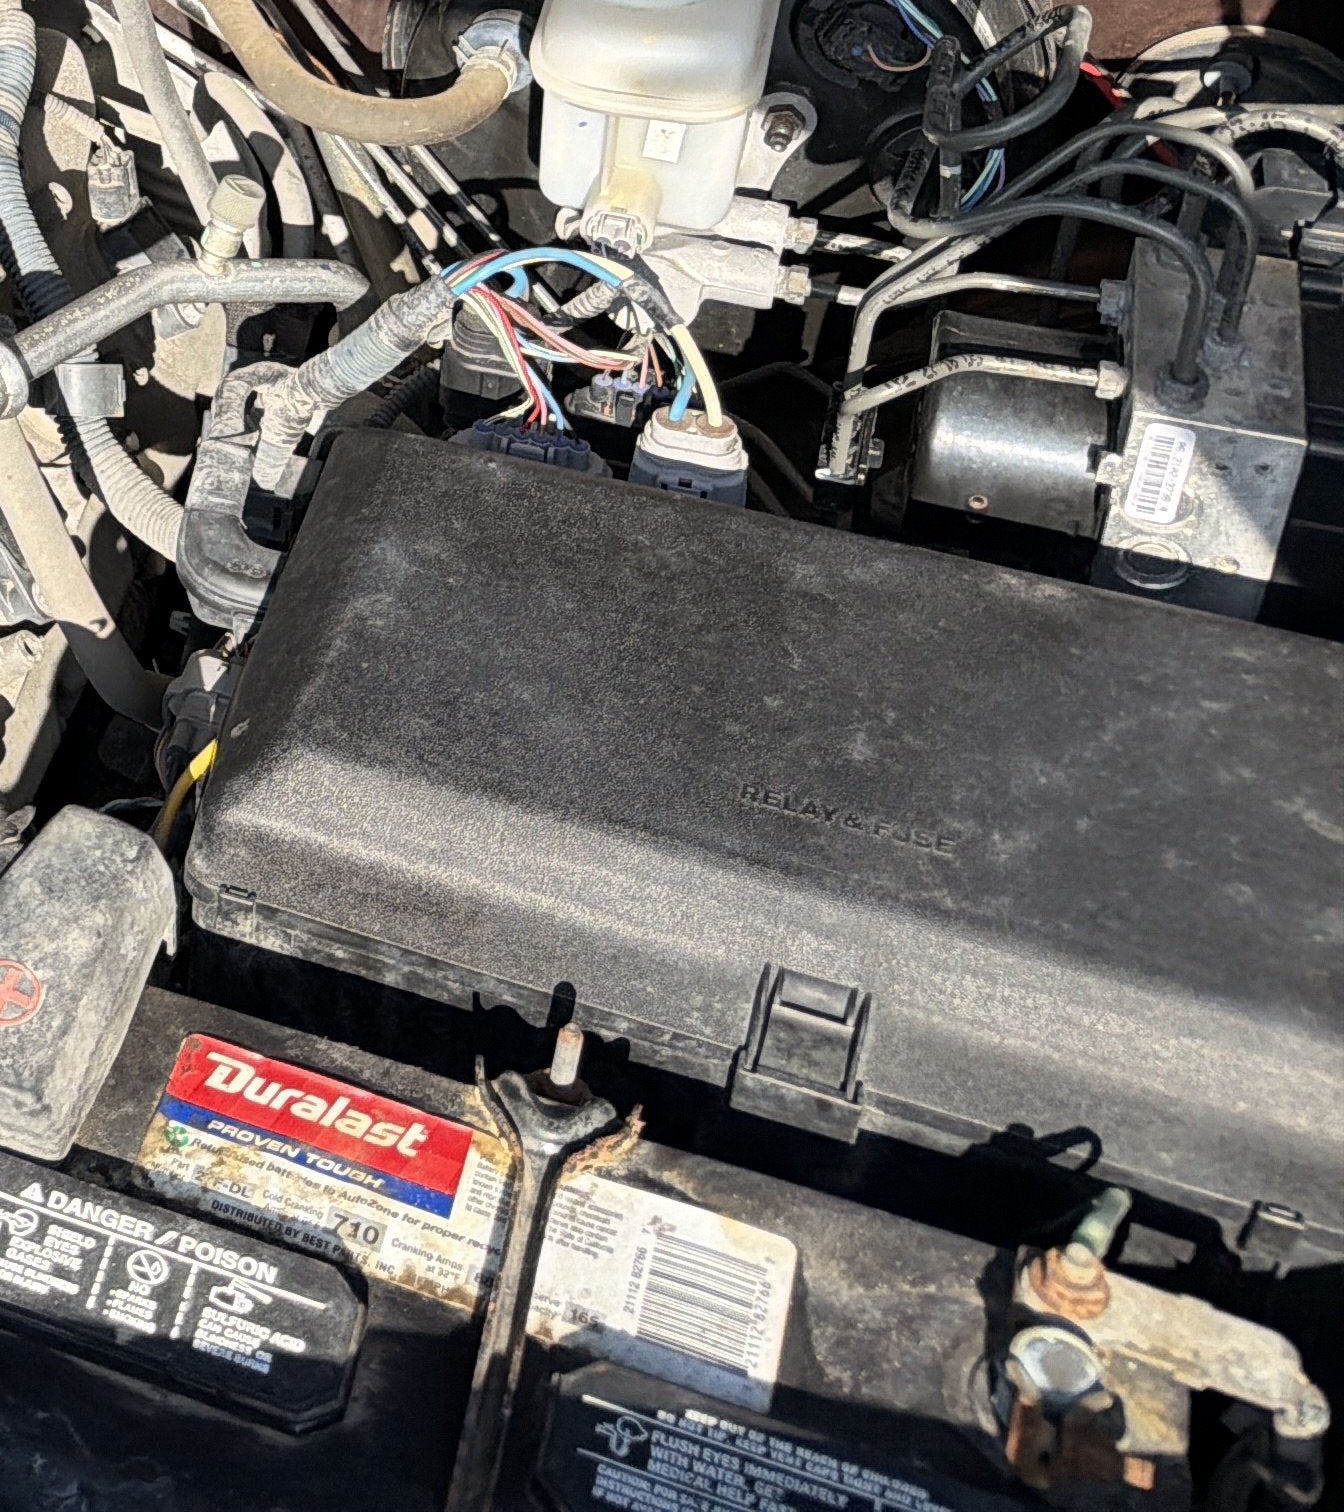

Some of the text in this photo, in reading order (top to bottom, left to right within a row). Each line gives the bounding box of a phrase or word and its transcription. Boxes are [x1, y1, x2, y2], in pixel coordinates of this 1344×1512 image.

[739, 782, 840, 826] RELAY
[873, 820, 958, 858] FUSE
[204, 1050, 431, 1158] Duralast
[207, 1119, 386, 1190] PROVEN TOUGH
[262, 1189, 283, 1203] Cold
[338, 1190, 400, 1219] AutoZone
[402, 1213, 421, 1227] for
[421, 1222, 467, 1242] proper
[43, 1235, 82, 1256] EYES
[46, 1189, 155, 1244] DANGER
[178, 1234, 280, 1285] POISON
[211, 1199, 282, 1233] DISTRIBUTED
[284, 1223, 300, 1239] BY
[302, 1232, 333, 1250] BEST
[334, 1212, 380, 1246] 710
[5, 1247, 52, 1272] GASES
[9, 1236, 83, 1272] EXPLOSIVE
[391, 1237, 464, 1271] Cranking Amps
[127, 1280, 152, 1296] NO
[201, 1306, 271, 1341] SULFURIC
[647, 1458, 715, 1494] MEDICAL
[716, 1482, 758, 1506] HELP
[650, 1429, 702, 1458] FLUSH
[702, 1446, 741, 1471] EYES
[743, 1459, 849, 1509] IMMEDIATELY
[650, 1444, 690, 1470] WITH
[754, 1479, 785, 1501] GET
